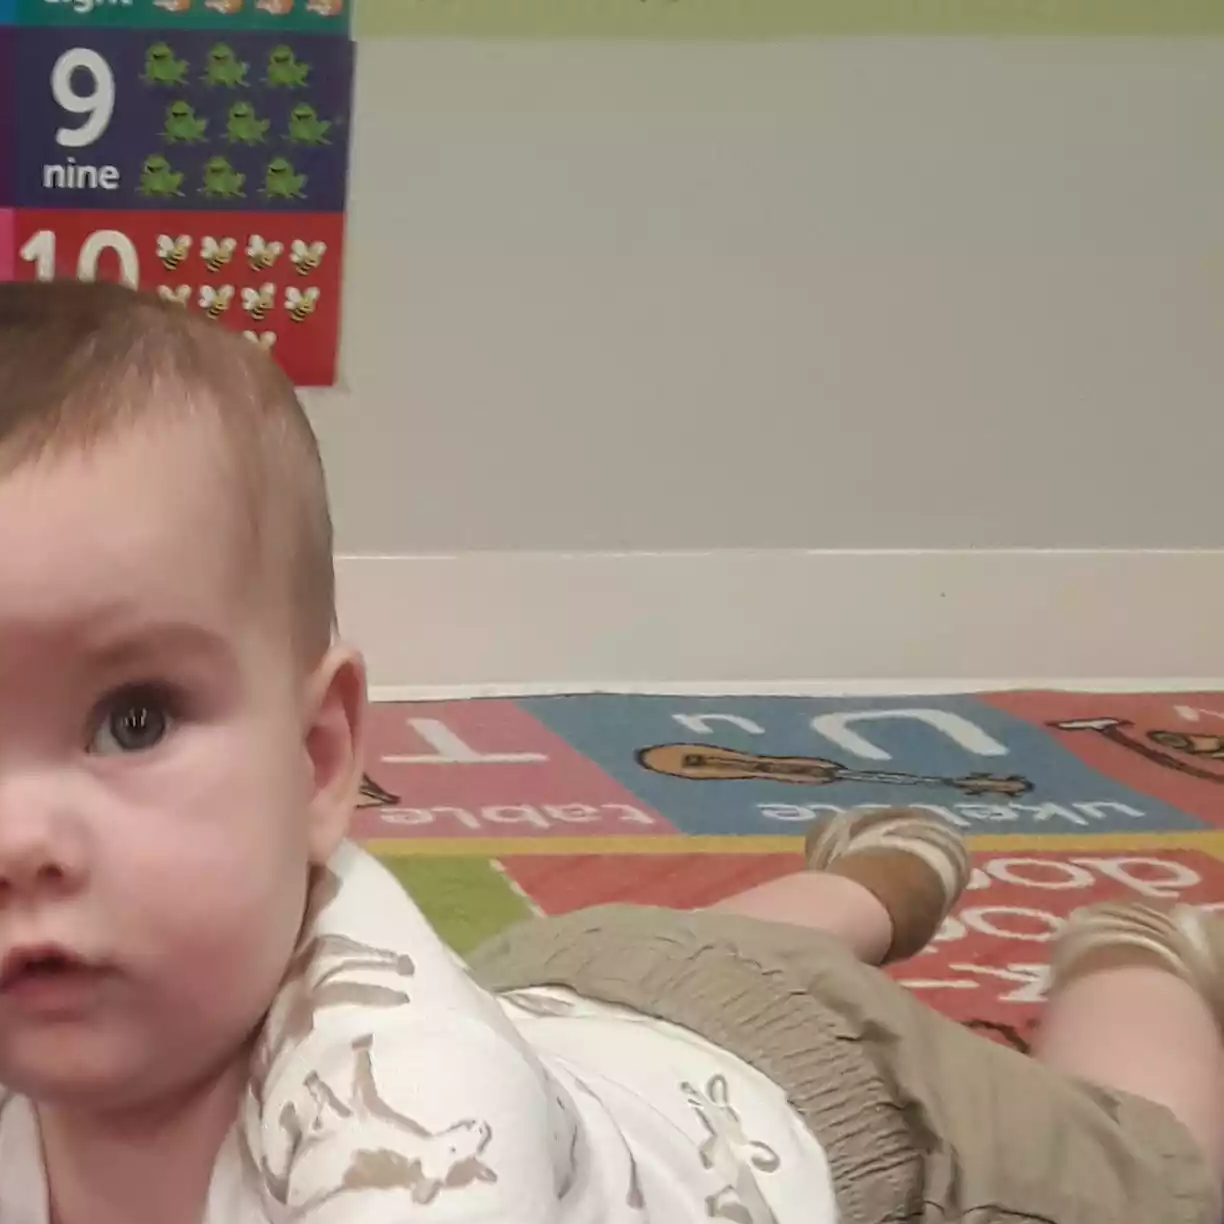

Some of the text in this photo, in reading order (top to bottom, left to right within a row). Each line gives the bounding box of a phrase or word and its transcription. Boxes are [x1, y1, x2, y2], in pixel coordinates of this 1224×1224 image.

[51, 48, 116, 146] 9
[43, 158, 120, 190] nine
[381, 716, 550, 764] T
[811, 708, 1010, 760] U
[379, 802, 656, 829] table
